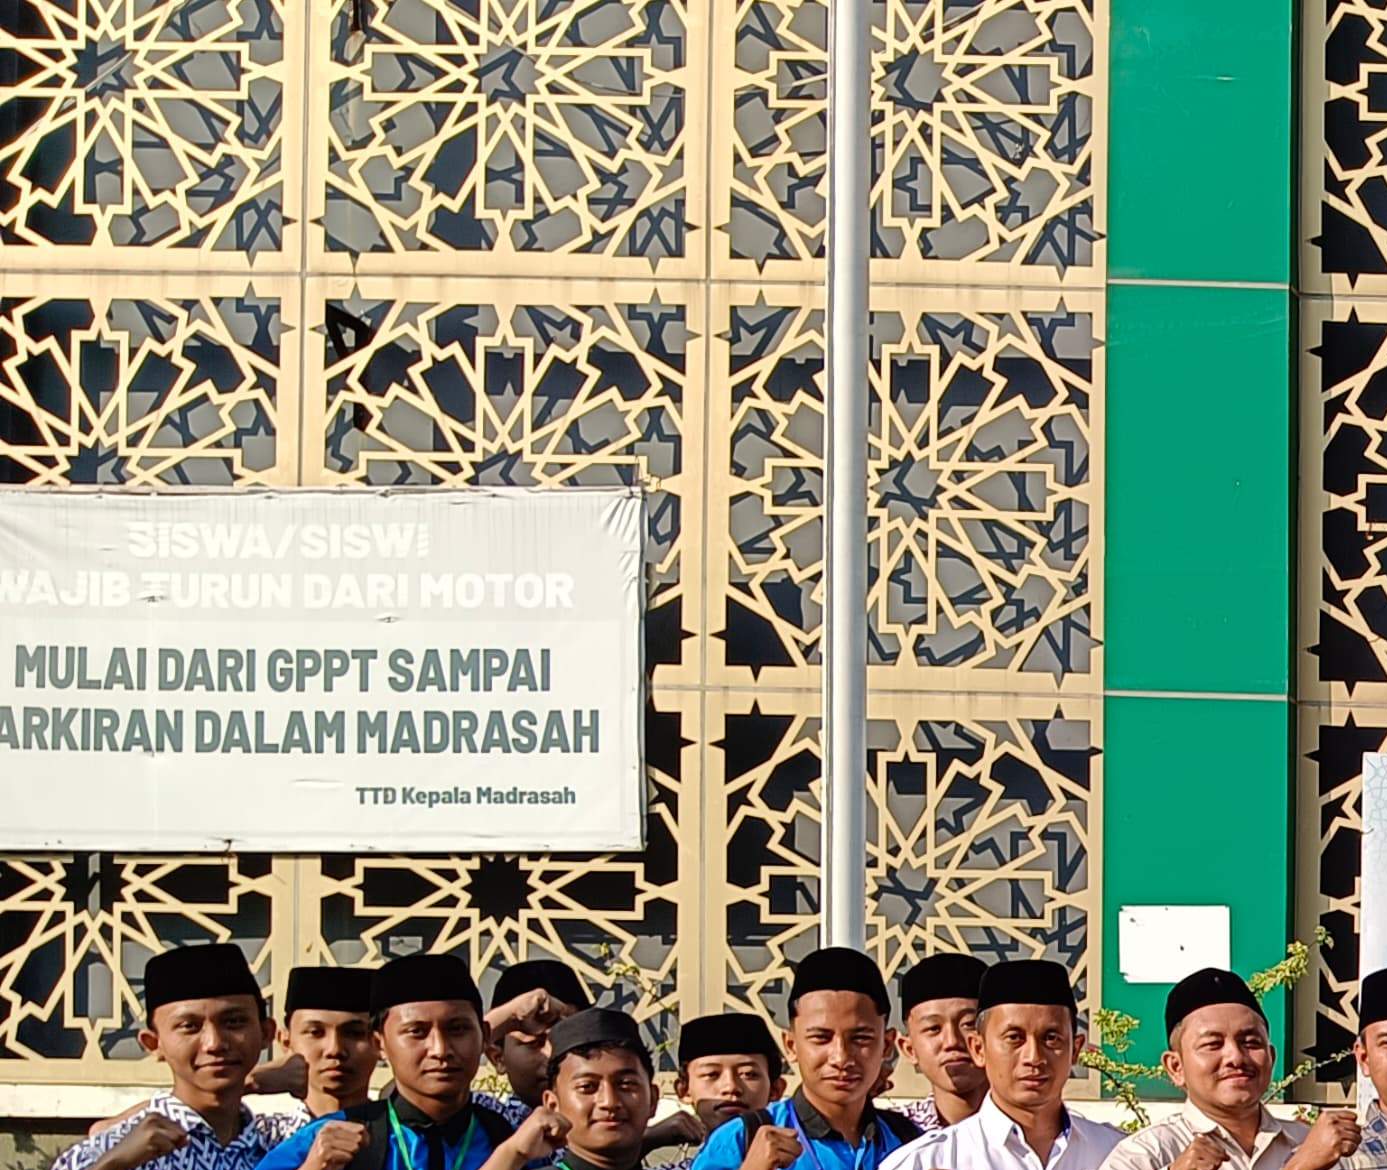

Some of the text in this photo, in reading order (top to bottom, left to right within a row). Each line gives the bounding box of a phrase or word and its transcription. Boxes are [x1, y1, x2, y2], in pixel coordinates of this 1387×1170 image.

[302, 572, 409, 609] DARI
[418, 572, 575, 609] MOTOR
[15, 644, 551, 693] MULAI DARI GPPT SAMPAI
[0, 705, 600, 754] ARKIRAN DALAM MADRASAH
[355, 786, 577, 808] TTD Kepala Madrasah
